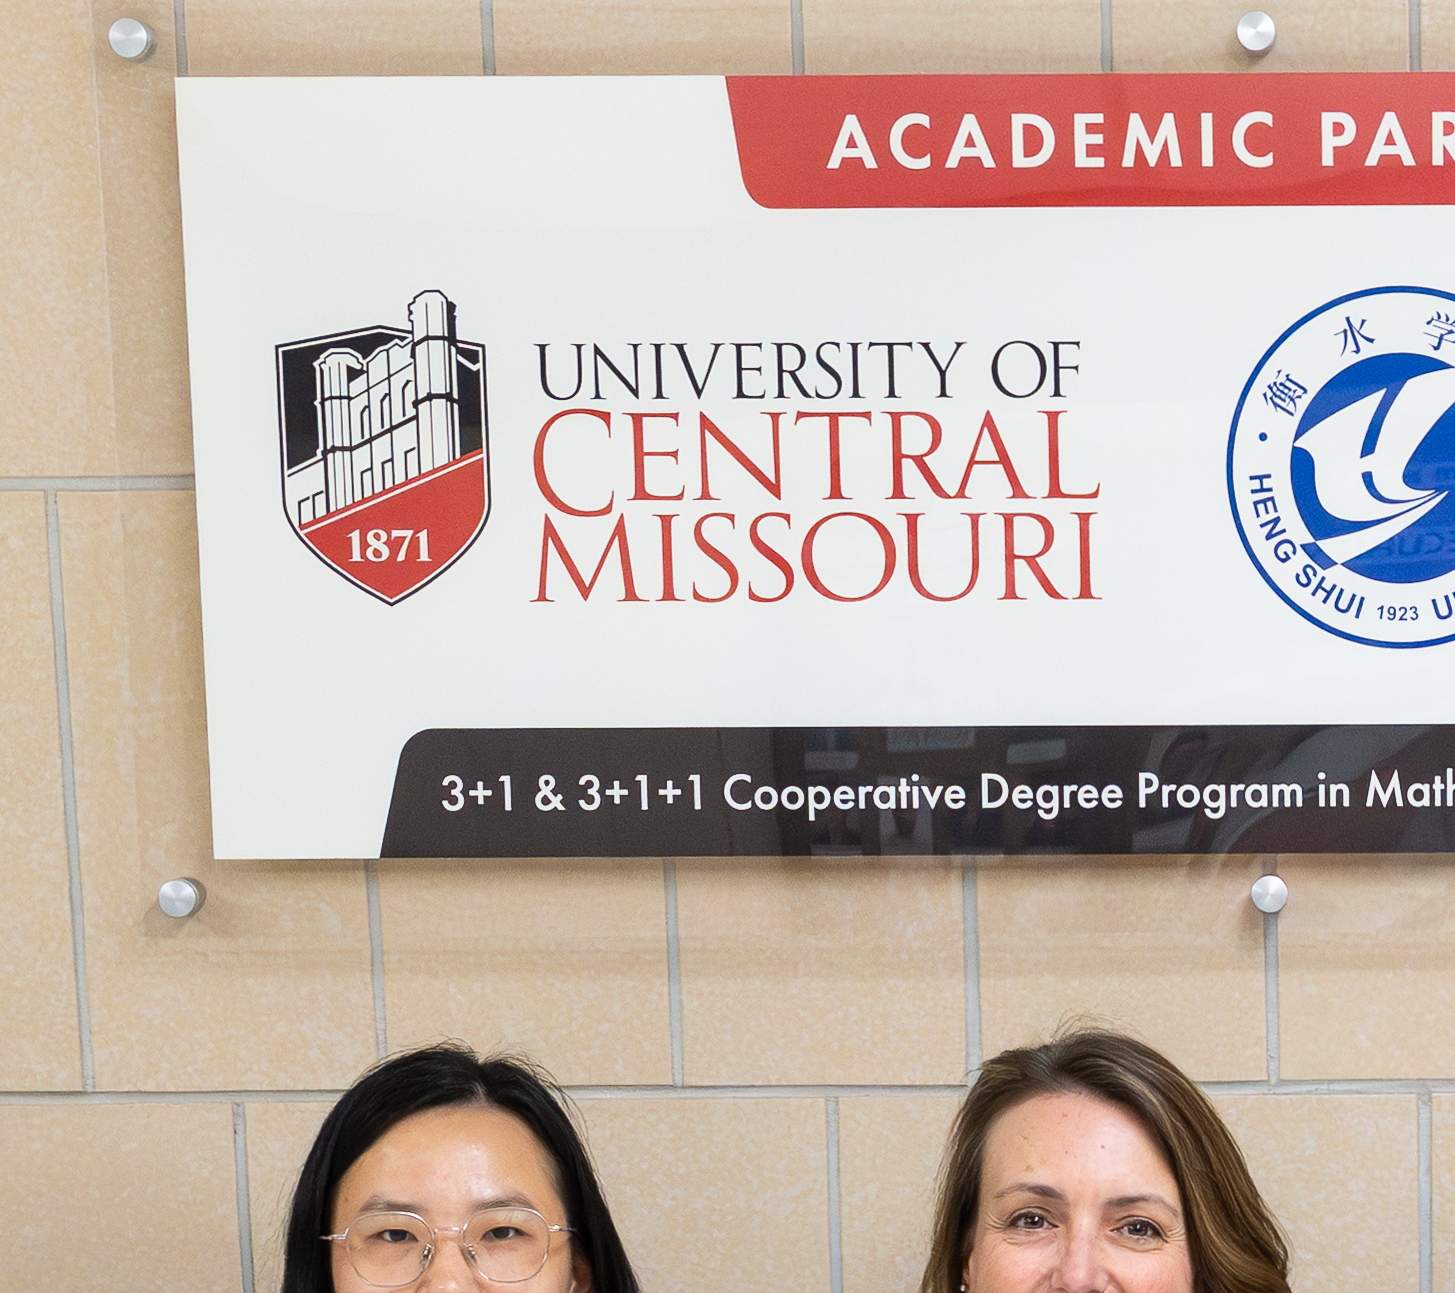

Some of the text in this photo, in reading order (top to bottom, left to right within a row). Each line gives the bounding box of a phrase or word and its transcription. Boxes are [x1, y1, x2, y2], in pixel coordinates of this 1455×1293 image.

[826, 110, 1274, 170] ACADEMIC
[533, 340, 1081, 401] UNIVERSITY OF
[533, 409, 1101, 516] CENTRAL
[347, 528, 432, 562] 1871
[529, 510, 1102, 604] MISSOURI
[1249, 473, 1298, 564] HENG
[1295, 563, 1365, 619] SHUI
[1377, 604, 1419, 622] 1923
[441, 774, 512, 812] 3+1
[534, 774, 566, 812] &
[578, 774, 702, 811] 3+1+1
[723, 773, 966, 820] Cooperative
[981, 772, 1124, 819] Degree
[1138, 772, 1303, 819] Program
[1317, 771, 1350, 807] in
